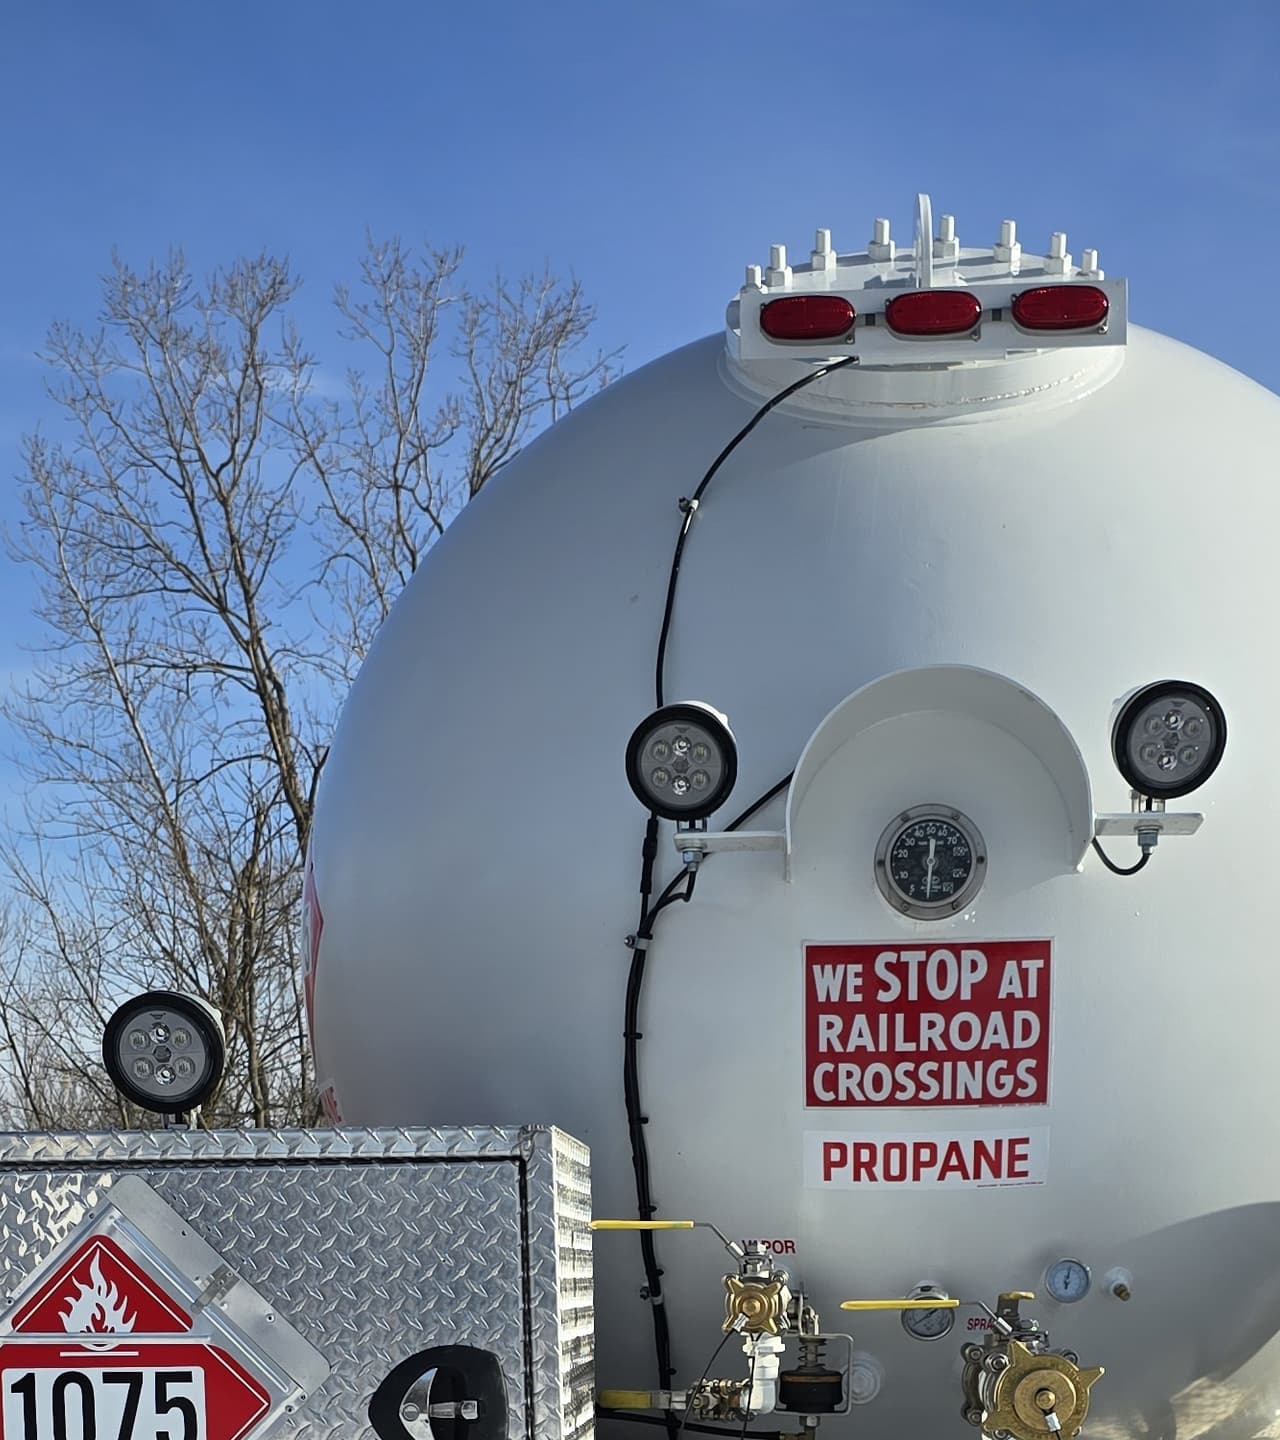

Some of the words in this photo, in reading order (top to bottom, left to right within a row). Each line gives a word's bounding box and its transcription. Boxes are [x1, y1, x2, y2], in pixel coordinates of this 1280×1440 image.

[897, 849, 909, 858] 20
[905, 837, 916, 846] 30
[947, 836, 958, 845] 70
[812, 963, 863, 1002] WE
[874, 948, 988, 1003] STOP
[997, 959, 1045, 1000] AT
[818, 1010, 1041, 1054] RAILROAD
[812, 1058, 1038, 1102] CROSSINGS
[822, 1137, 1031, 1183] PROPANE
